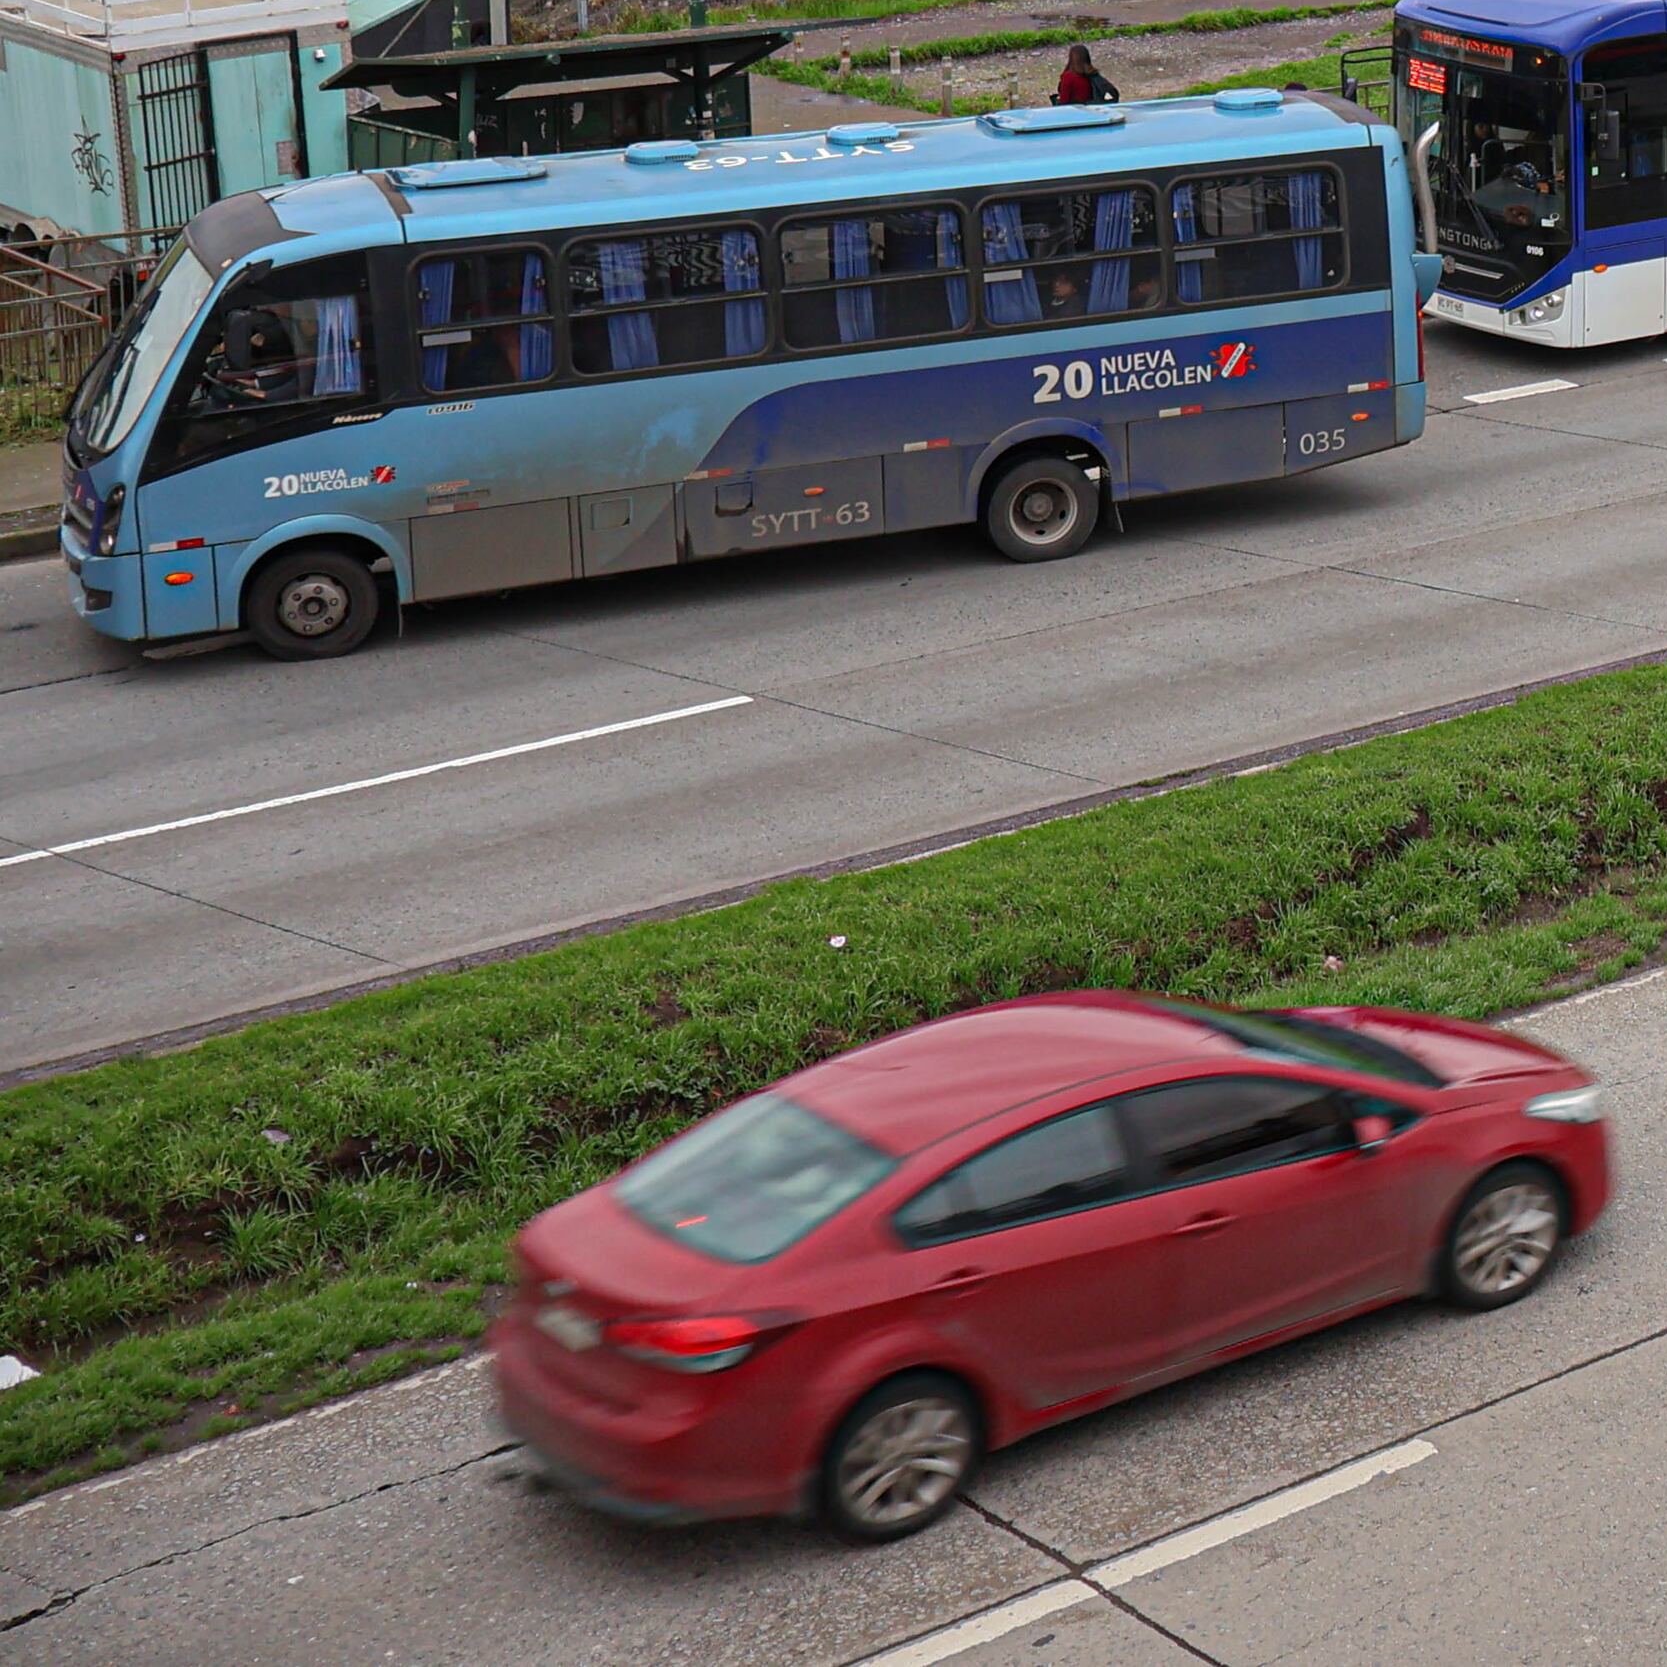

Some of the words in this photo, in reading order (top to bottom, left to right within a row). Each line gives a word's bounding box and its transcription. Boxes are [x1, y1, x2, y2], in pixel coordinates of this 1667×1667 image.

[1033, 360, 1094, 405] 20
[1101, 348, 1176, 376] NUEVA
[1101, 363, 1213, 396] LLACOLEN
[1299, 428, 1346, 455] 035
[264, 473, 299, 499] 20
[300, 467, 347, 483] NUEVA
[300, 476, 369, 495] LLACOLEN
